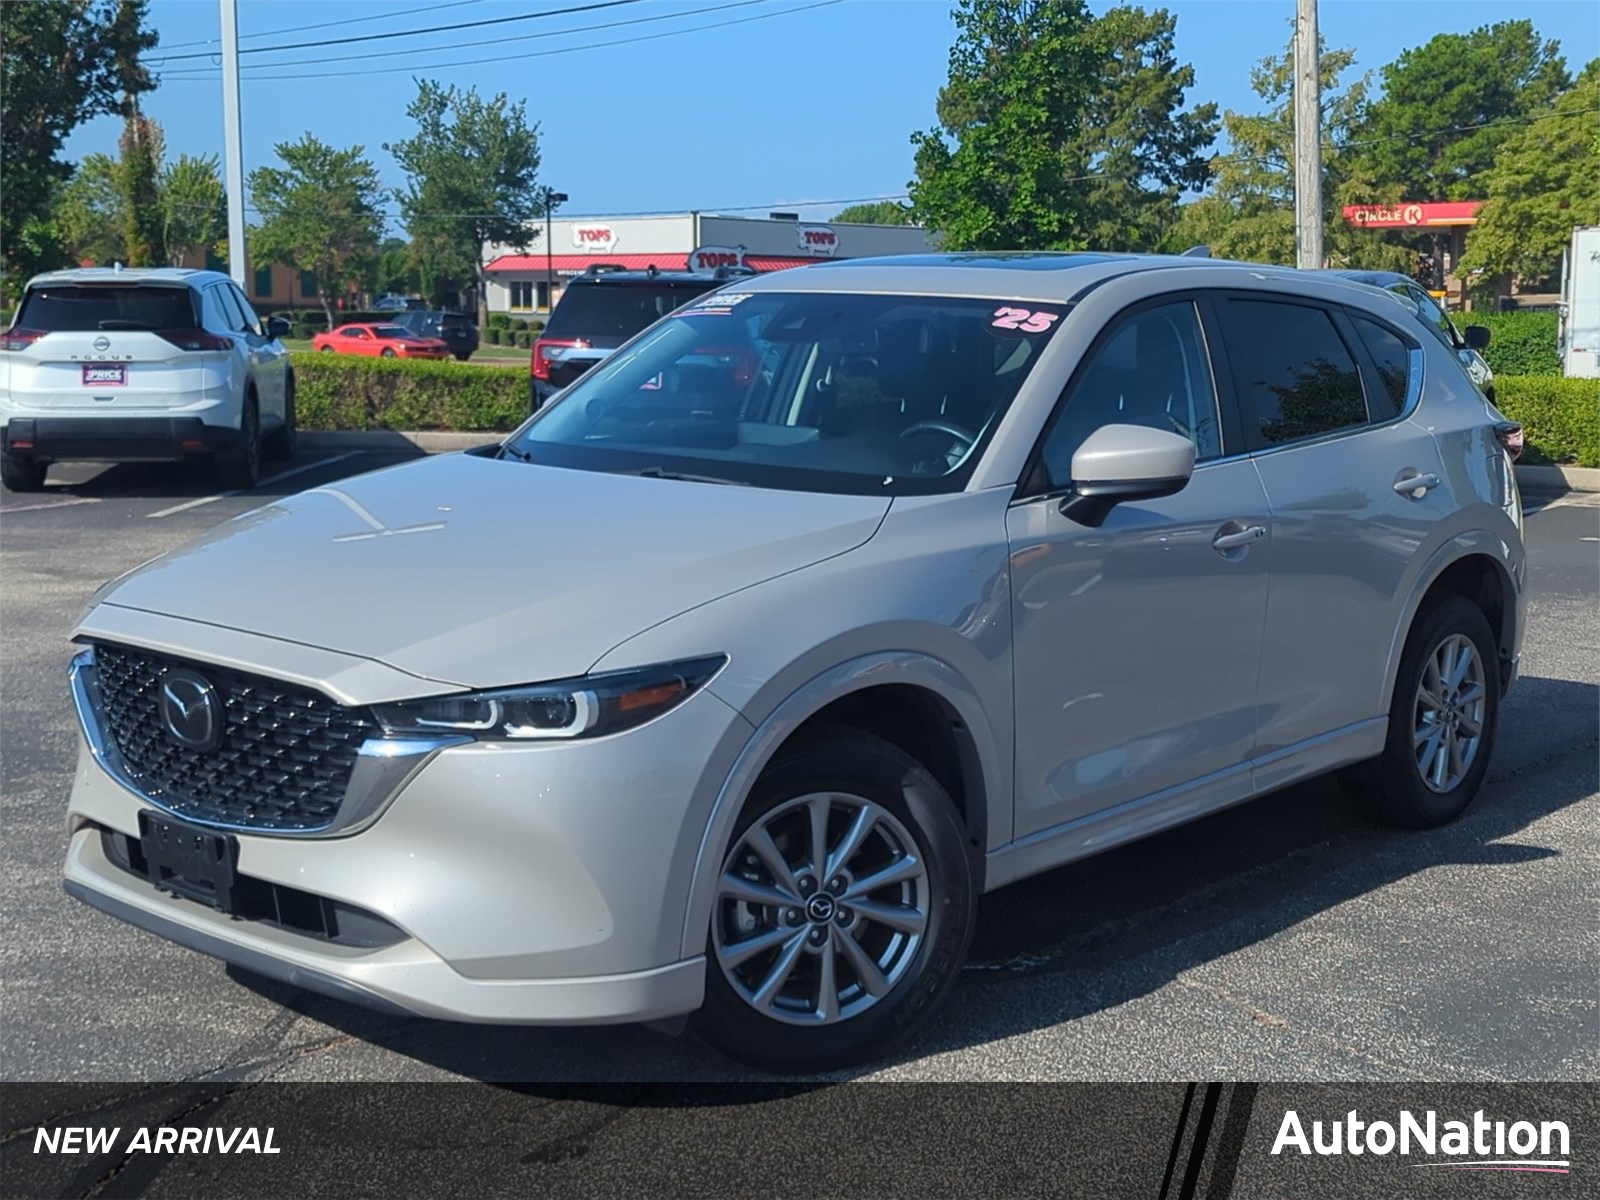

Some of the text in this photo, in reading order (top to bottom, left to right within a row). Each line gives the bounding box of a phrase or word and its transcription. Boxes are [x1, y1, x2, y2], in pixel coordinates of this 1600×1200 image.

[1408, 208, 1421, 224] K
[578, 229, 611, 242] TOPS
[804, 231, 836, 245] TOPS
[696, 252, 739, 268] TOPS
